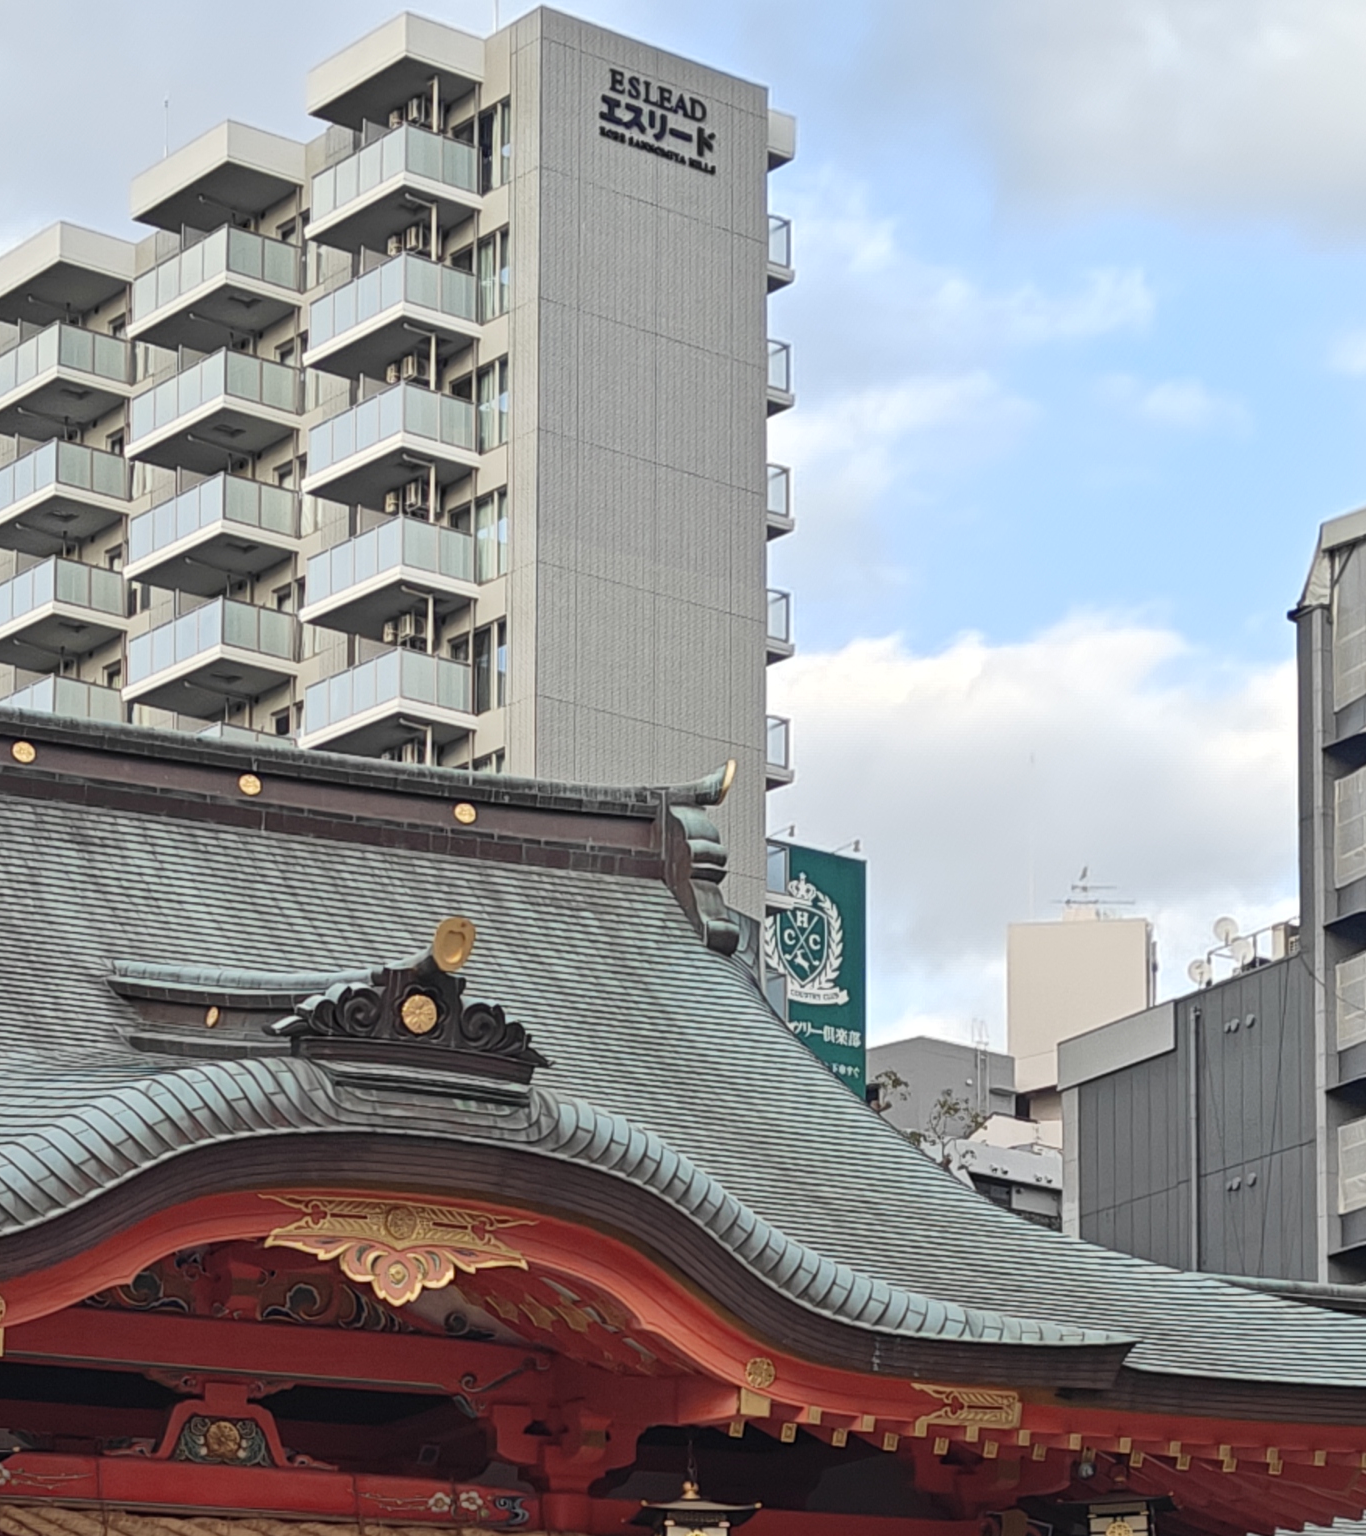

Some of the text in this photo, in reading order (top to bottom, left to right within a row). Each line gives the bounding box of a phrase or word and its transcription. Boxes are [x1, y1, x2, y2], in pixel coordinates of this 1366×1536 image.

[609, 68, 707, 123] ESLEAD
[598, 93, 717, 158] エスリード
[628, 136, 687, 166] SANNOMIYA
[688, 157, 716, 176] HILLS
[784, 928, 821, 950] C C
[796, 910, 809, 928] H
